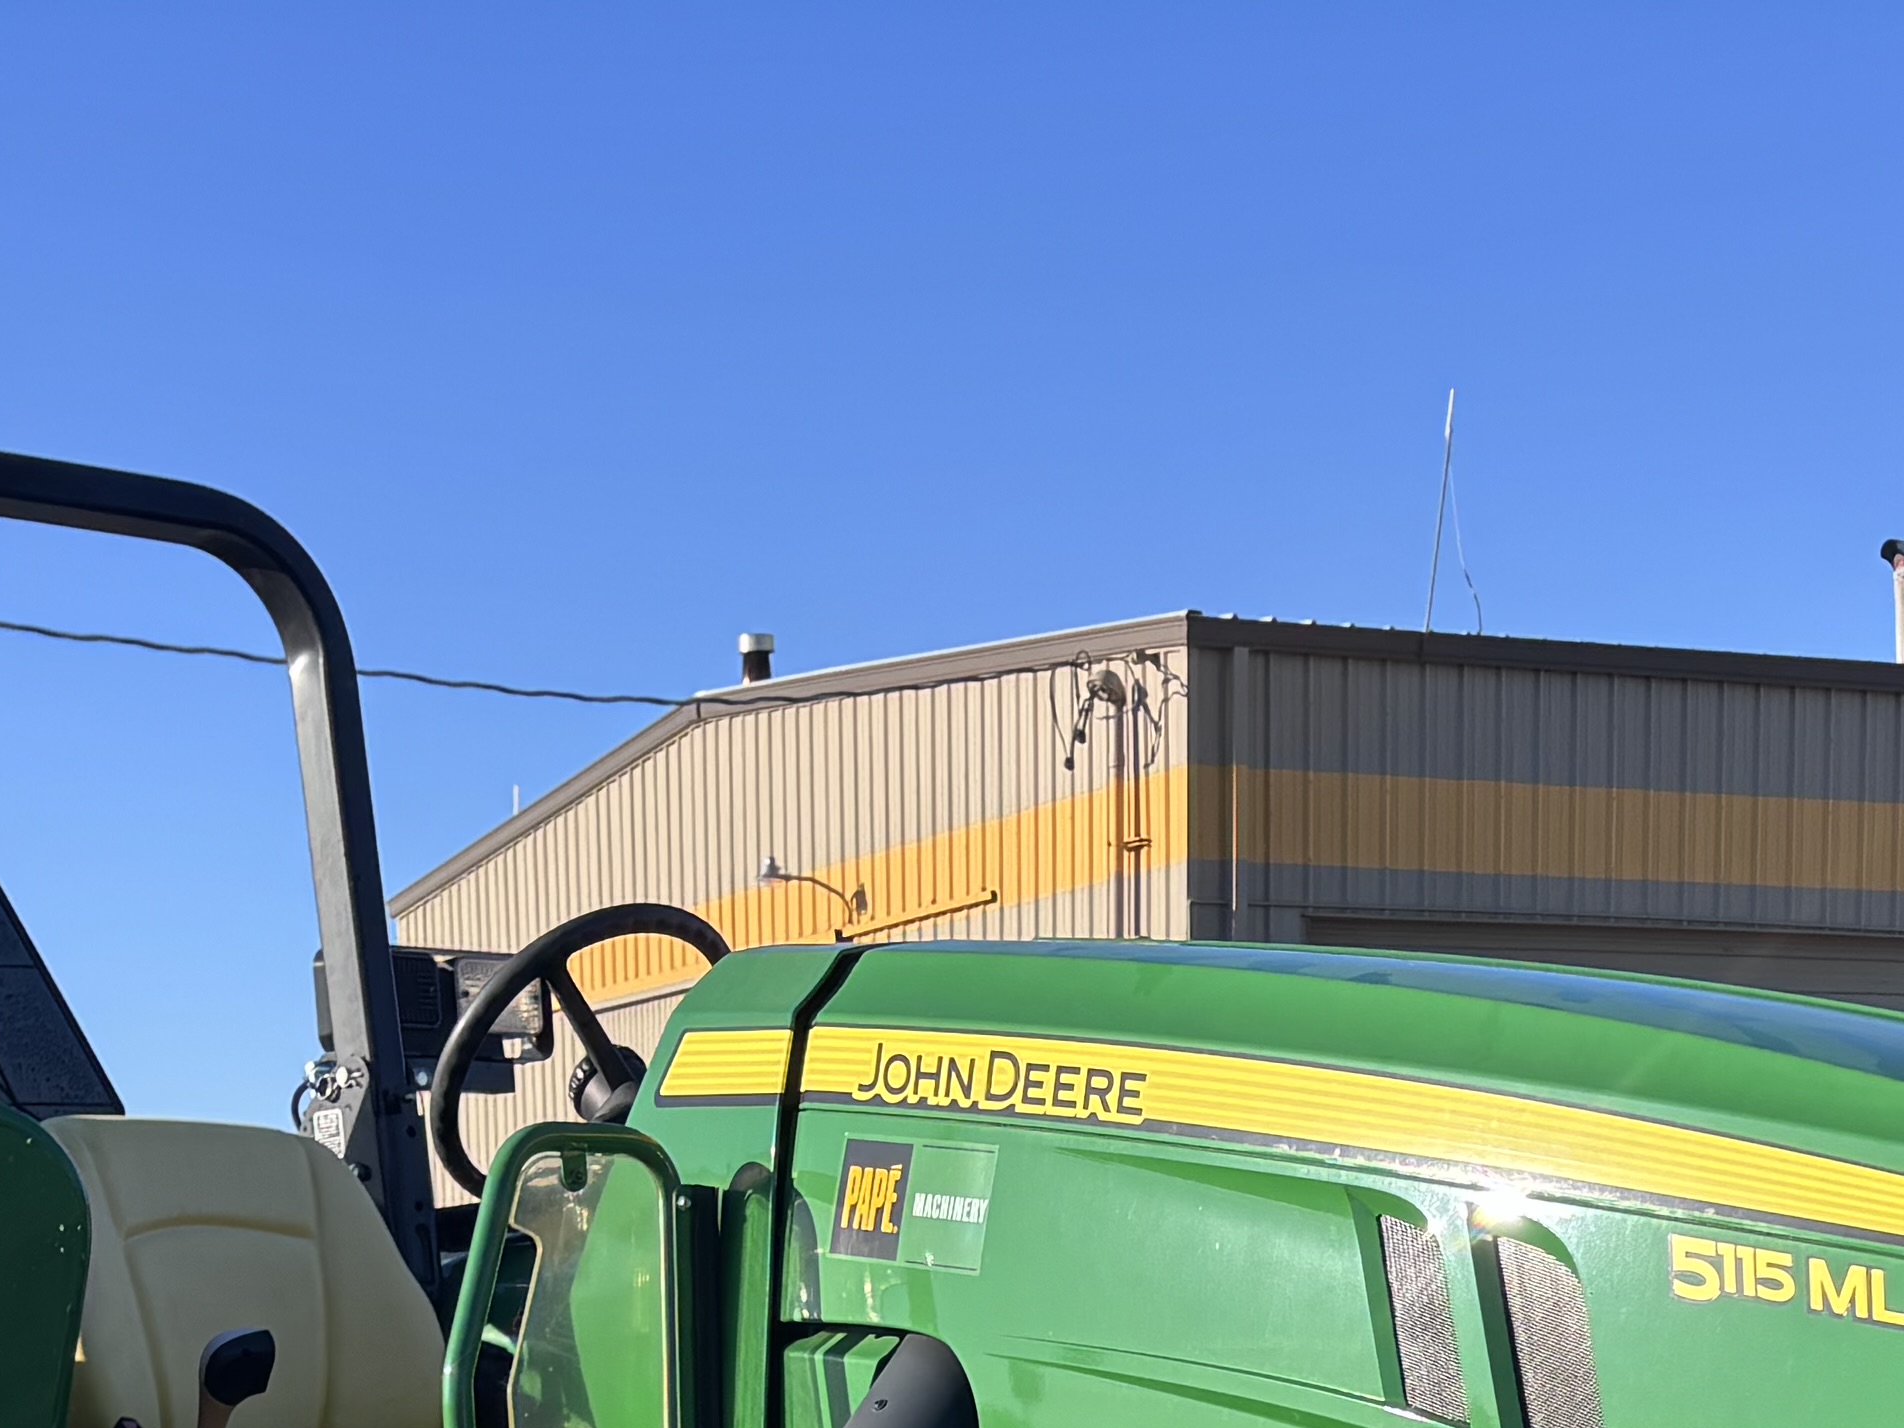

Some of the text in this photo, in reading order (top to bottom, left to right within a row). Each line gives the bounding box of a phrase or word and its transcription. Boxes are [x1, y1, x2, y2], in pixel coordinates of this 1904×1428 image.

[857, 1041, 1148, 1117] JOHN DEERE
[912, 1192, 989, 1224] MACHINERY
[1669, 1233, 1796, 1304] 5115
